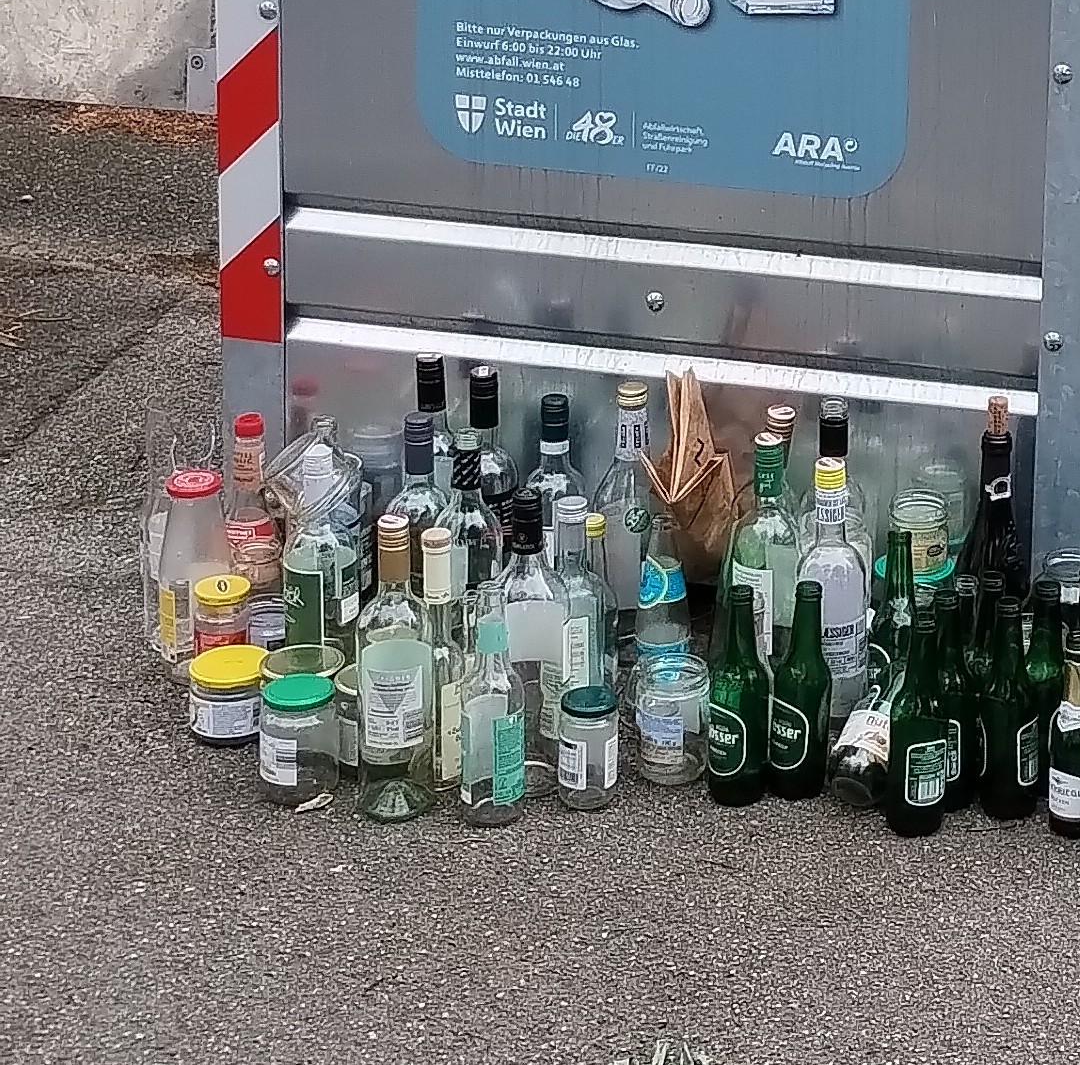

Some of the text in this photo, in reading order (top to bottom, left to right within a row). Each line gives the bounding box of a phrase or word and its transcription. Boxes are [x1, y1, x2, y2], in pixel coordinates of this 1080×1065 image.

[456, 22, 640, 49] Bitte nur Verpackungen aus Glas.
[456, 37, 602, 60] Einwurf 6:00 bis 22:00 Uhr
[455, 52, 566, 72] www.abfall.wien.at
[456, 67, 580, 88] Misttelefon: 01 546 48
[495, 98, 548, 120] Stadt
[495, 118, 547, 140] Wien
[772, 131, 844, 163] ARA
